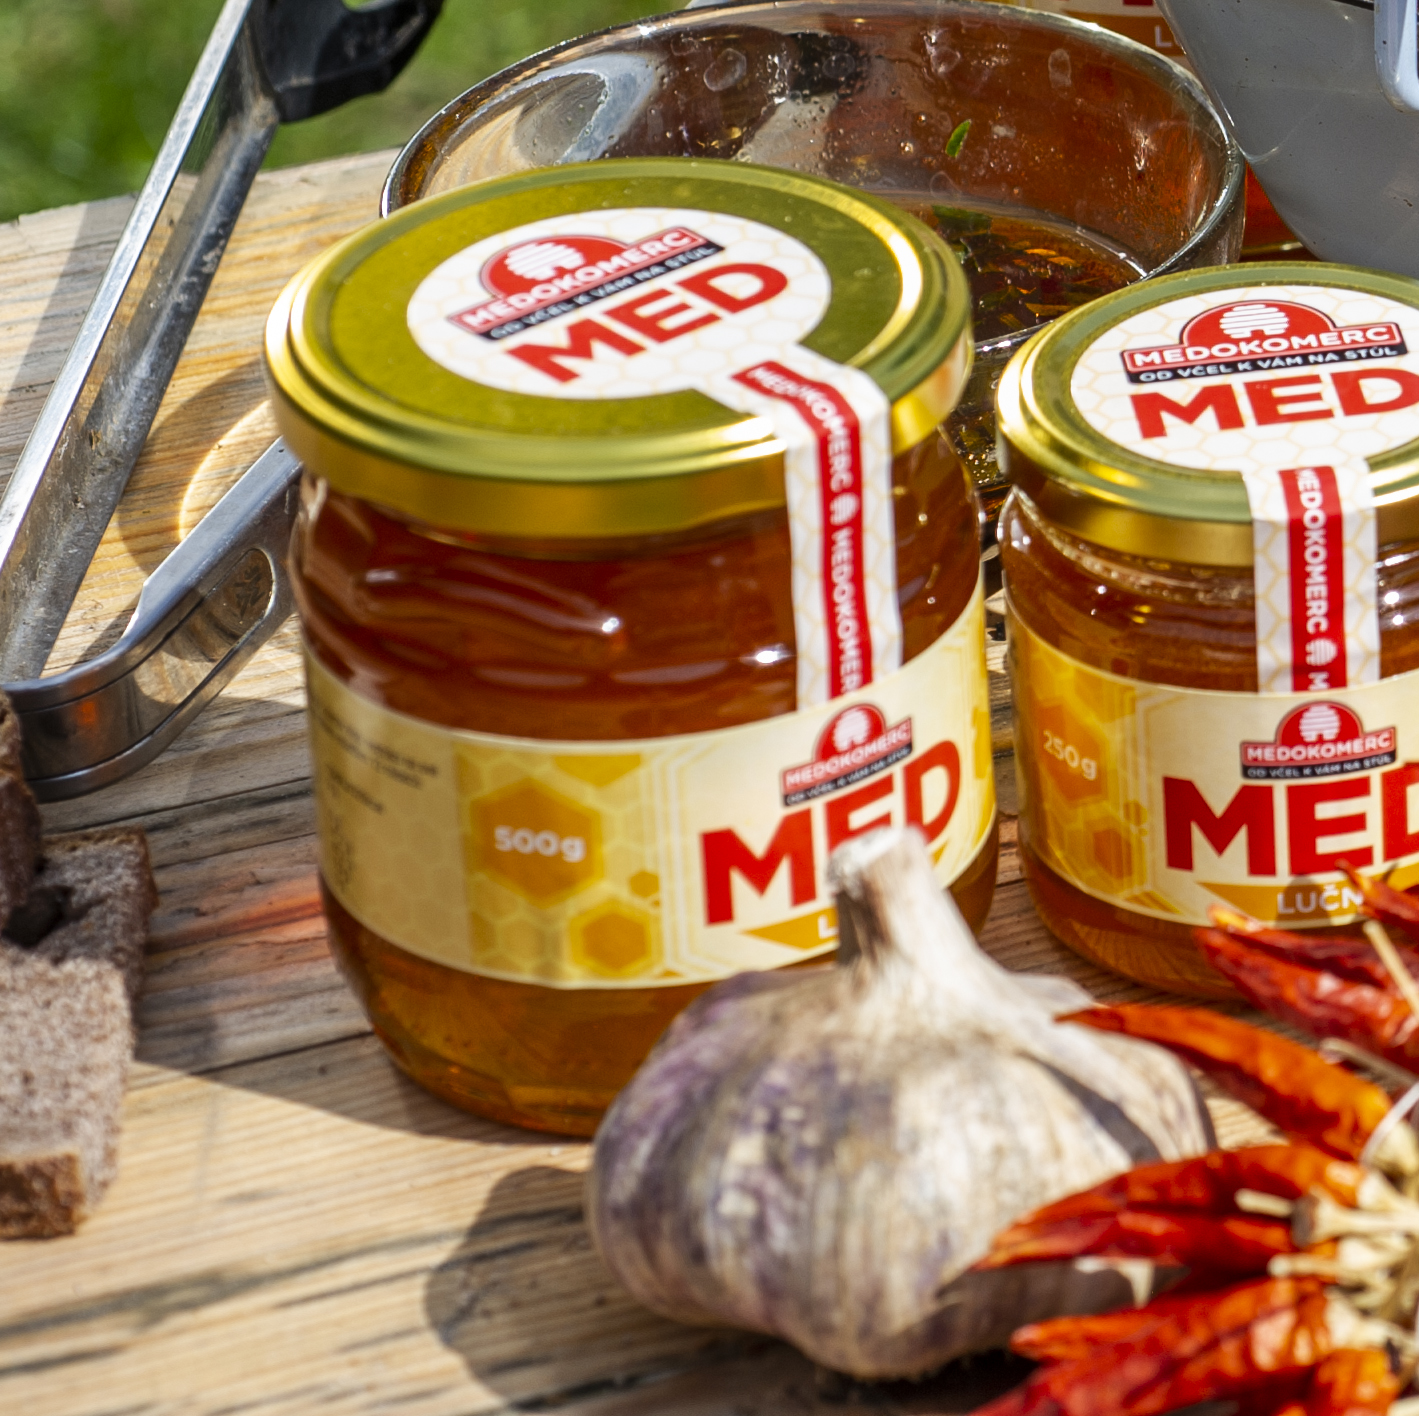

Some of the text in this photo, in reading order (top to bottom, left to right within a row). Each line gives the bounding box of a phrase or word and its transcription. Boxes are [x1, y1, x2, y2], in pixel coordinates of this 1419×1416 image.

[461, 230, 693, 328] MEDOKOMERC
[506, 263, 787, 384] MED
[1134, 327, 1390, 367] MEDOKOMERC
[1138, 369, 1173, 383] OD
[1237, 361, 1254, 373] K
[1308, 352, 1341, 364] NA
[1295, 468, 1330, 634] MEDOKOMERC
[784, 722, 911, 787] MEDOKOMERC
[1247, 734, 1391, 762] MEDOKOMERC
